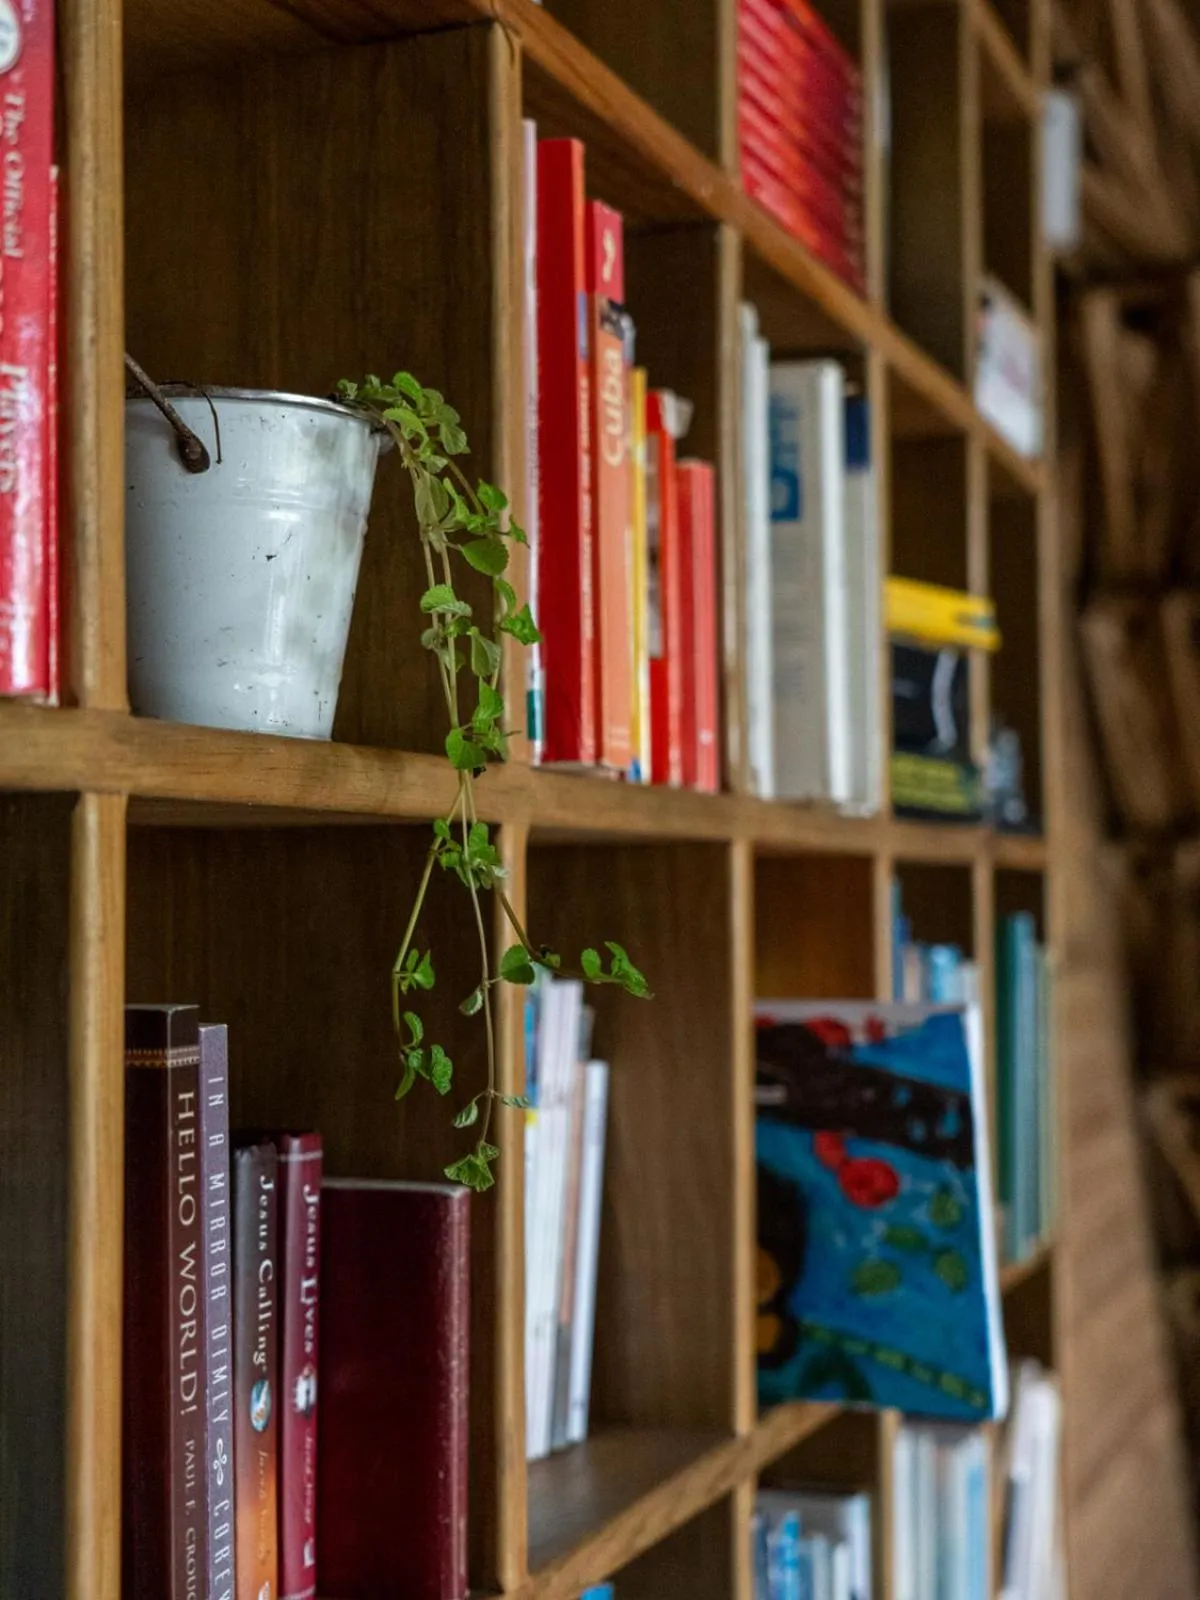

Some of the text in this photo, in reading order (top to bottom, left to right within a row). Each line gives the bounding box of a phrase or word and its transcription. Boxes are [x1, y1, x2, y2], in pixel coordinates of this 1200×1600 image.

[4, 89, 26, 258] The Official
[602, 347, 625, 468] Cuba
[178, 1091, 198, 1416] HELLO WORLD!
[208, 1076, 229, 1423] IN A MIRROR DIMLY
[259, 1175, 274, 1251] Jesus
[301, 1184, 319, 1354] Jesus Lives
[184, 1439, 196, 1493] PAUL
